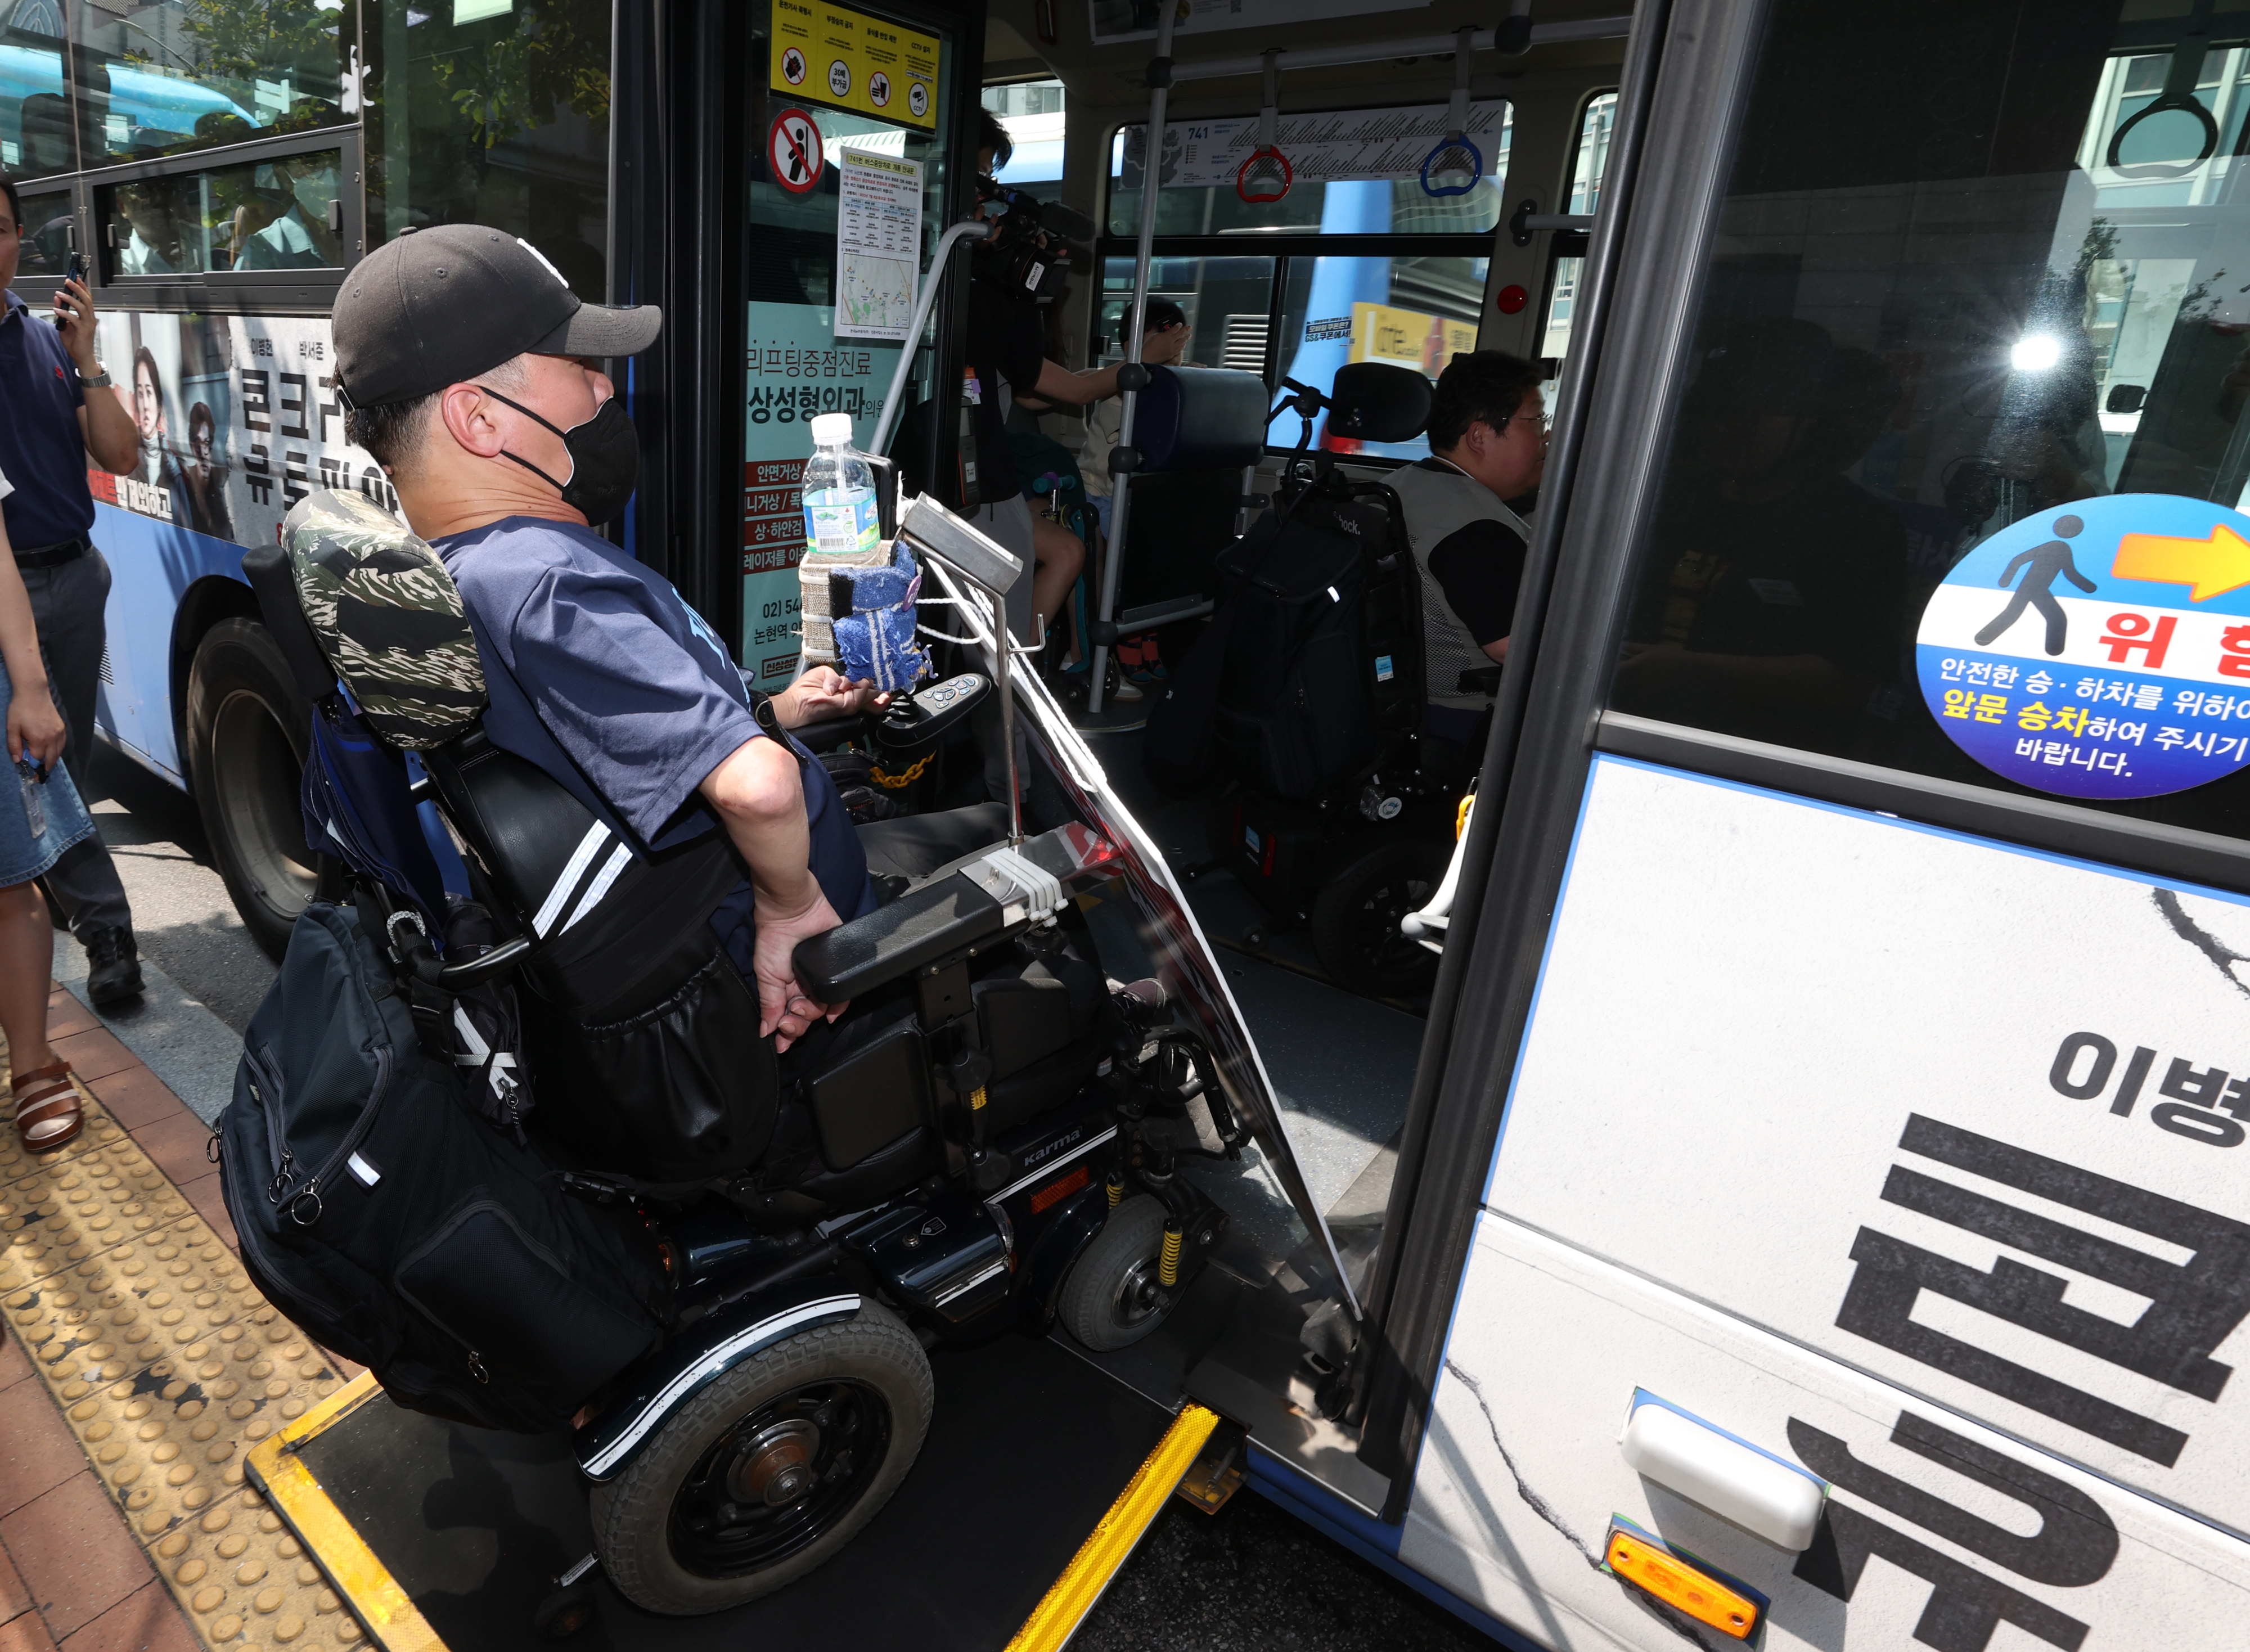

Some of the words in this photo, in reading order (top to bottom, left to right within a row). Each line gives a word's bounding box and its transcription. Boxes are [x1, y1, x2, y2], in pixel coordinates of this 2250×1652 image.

[912, 42, 922, 51] CCTV
[832, 77, 847, 89] 부가금
[834, 68, 845, 78] 30배
[1189, 127, 1208, 139] 741
[850, 155, 863, 164] 741번
[747, 348, 871, 377] 리프팅중점진료
[757, 463, 801, 483] 안면거상
[754, 519, 802, 541] 상·하안검
[744, 549, 786, 570] 레이저를
[763, 600, 781, 618] 02)
[754, 623, 788, 645] 논현역
[2099, 613, 2179, 669] 위
[1941, 658, 2019, 690] 안전한
[1942, 688, 2008, 724] 앞문
[2017, 701, 2146, 746] 승차하여
[2153, 726, 2249, 762] 주시기
[2015, 738, 2133, 777] 바랍니다.
[1024, 1128, 1081, 1167] karma
